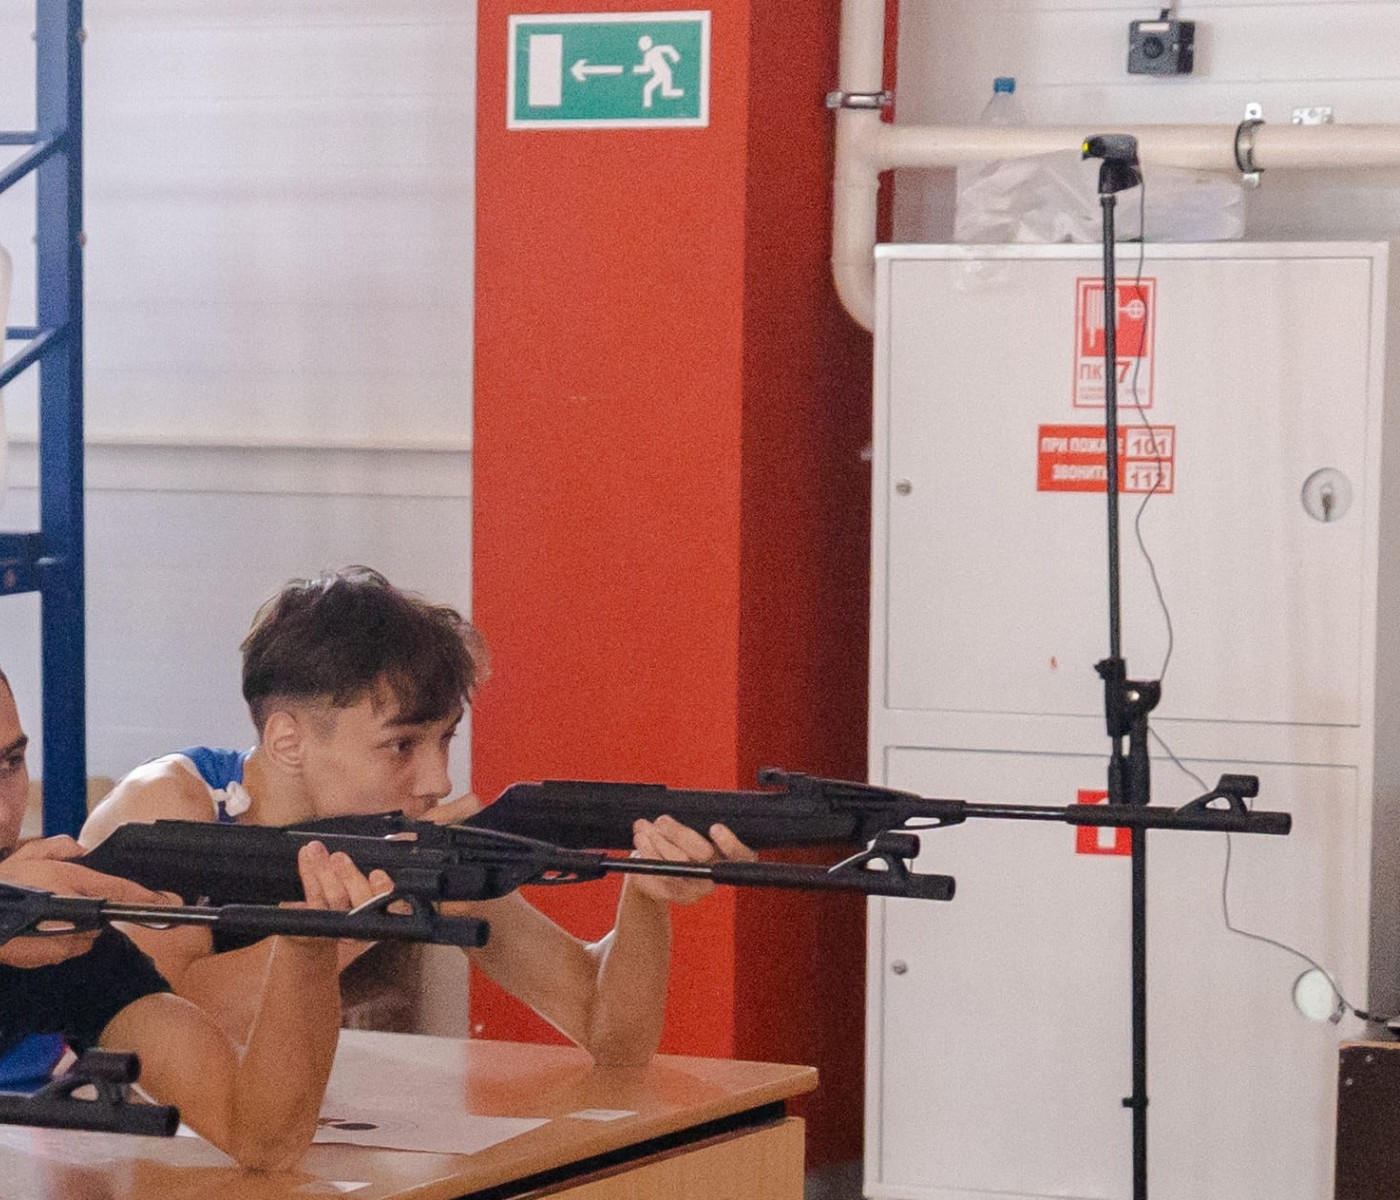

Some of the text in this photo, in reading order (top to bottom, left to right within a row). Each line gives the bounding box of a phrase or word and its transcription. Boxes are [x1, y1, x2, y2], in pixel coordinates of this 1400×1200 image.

[1080, 361, 1132, 384] ПК 7
[1041, 437, 1124, 454] ПРИ ПОЖАЕ
[1132, 438, 1167, 455] 101
[1130, 471, 1166, 488] 112
